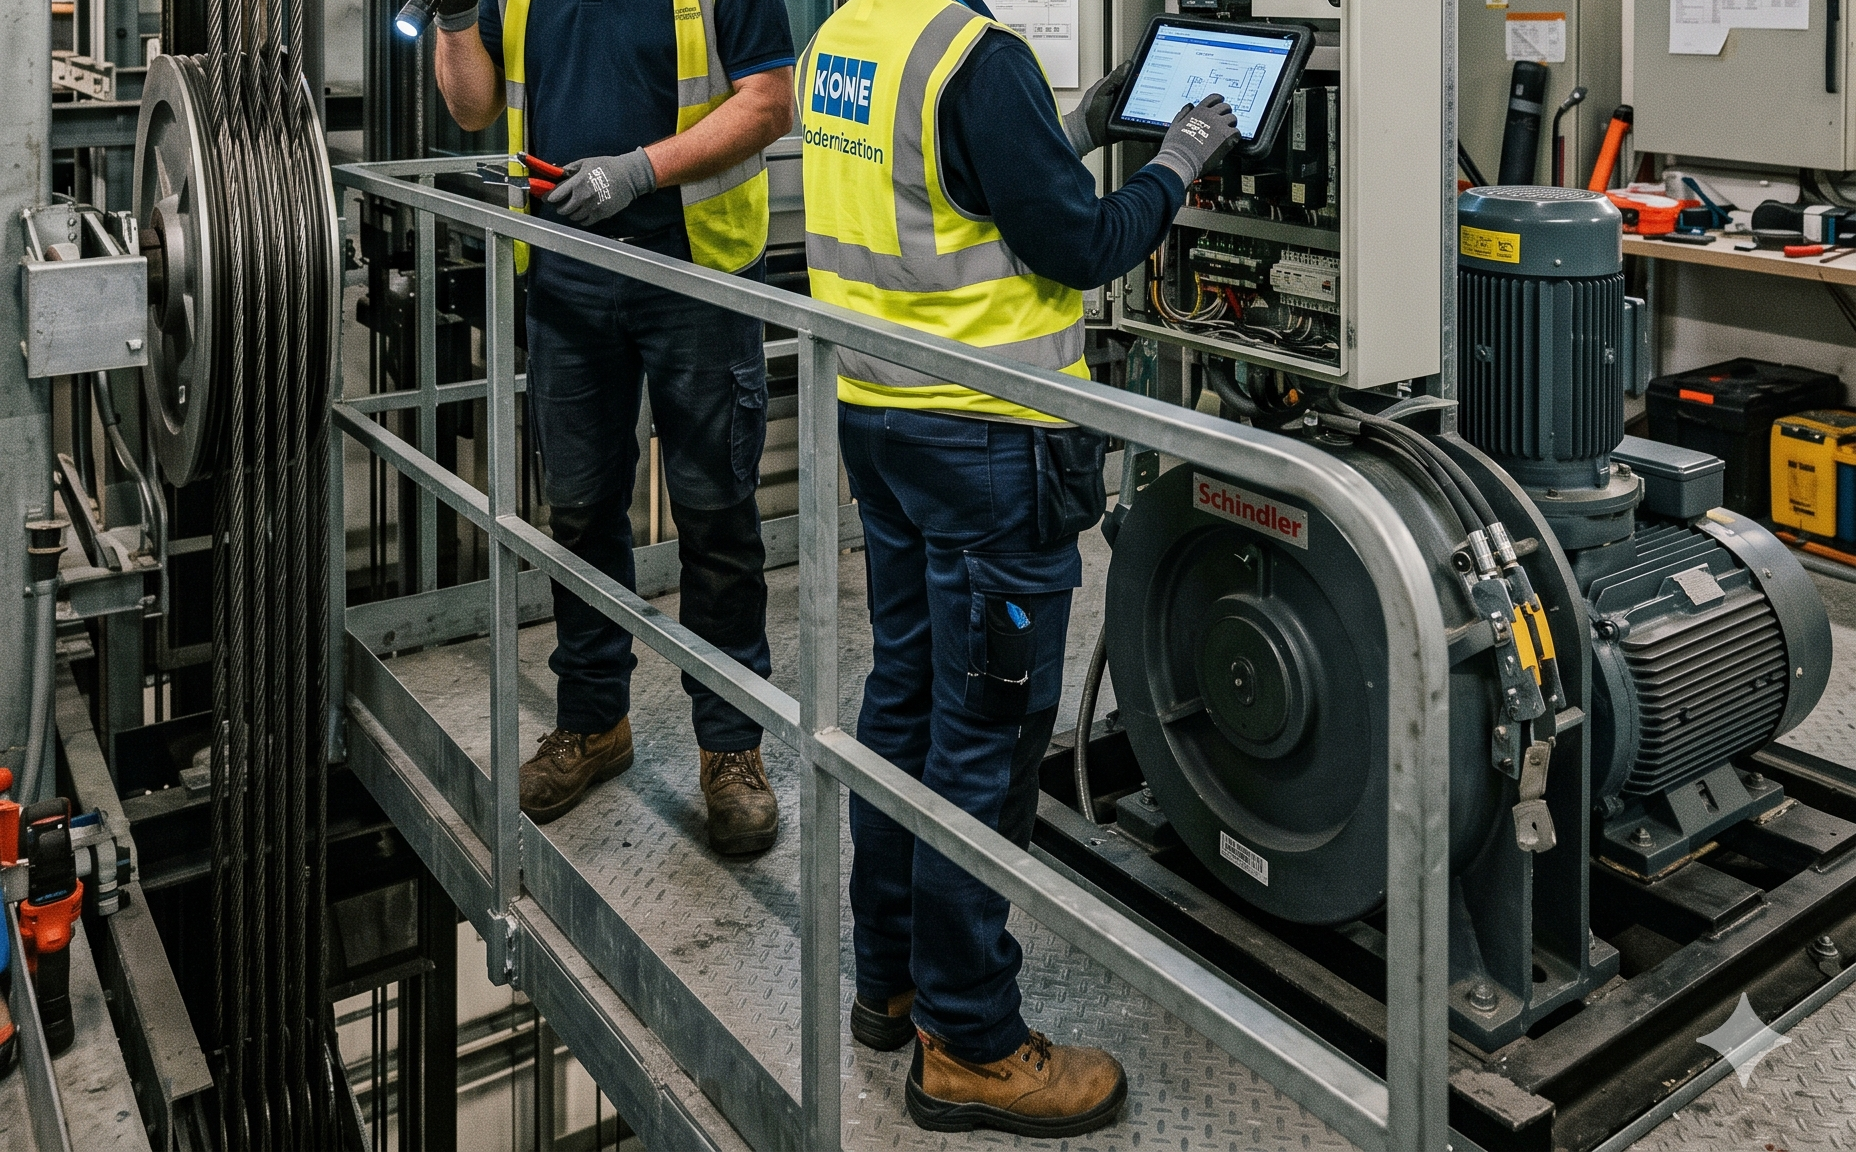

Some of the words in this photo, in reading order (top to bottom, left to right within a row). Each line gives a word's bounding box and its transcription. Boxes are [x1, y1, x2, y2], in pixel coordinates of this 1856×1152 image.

[814, 69, 871, 107] KONE
[803, 124, 883, 165] odernization
[1199, 482, 1302, 538] Schindler
